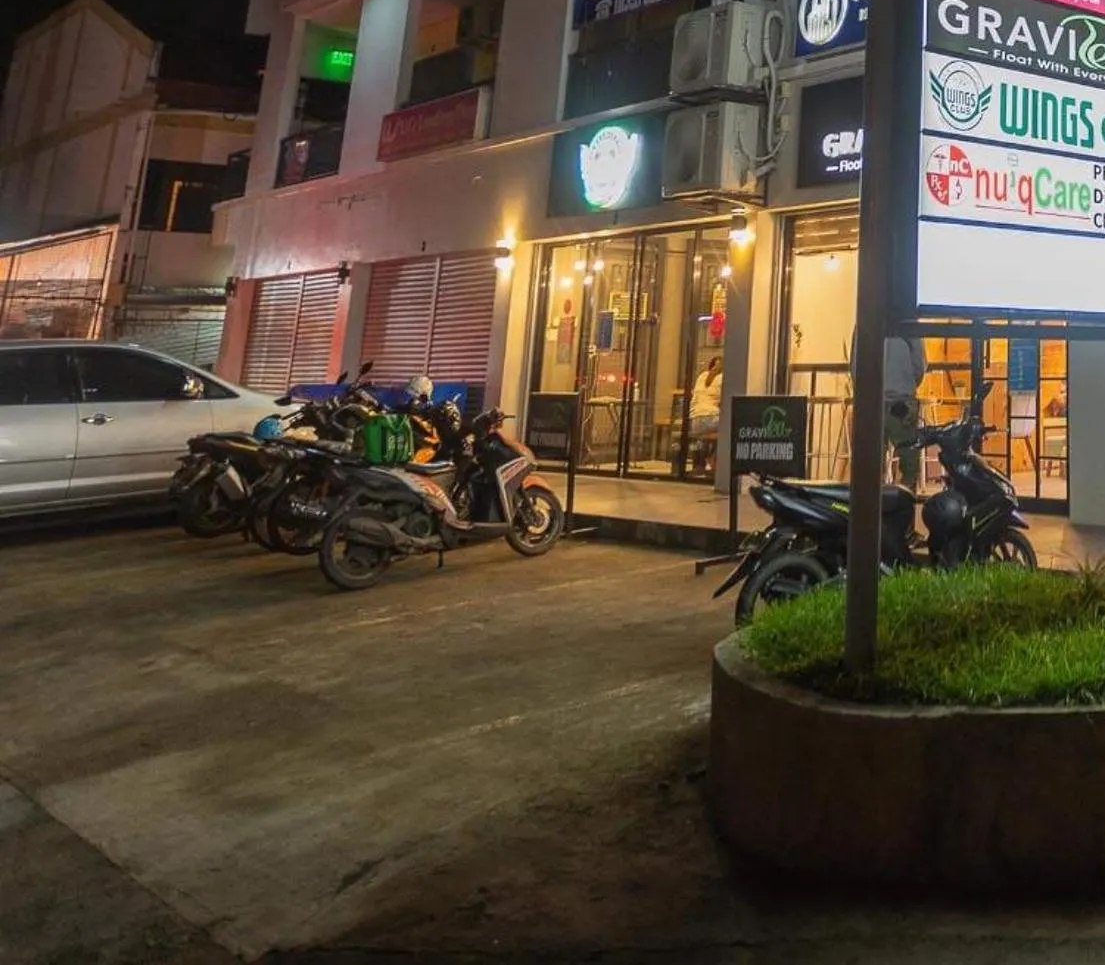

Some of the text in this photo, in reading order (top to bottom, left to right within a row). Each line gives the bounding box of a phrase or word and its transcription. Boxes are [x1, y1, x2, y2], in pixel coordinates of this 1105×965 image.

[993, 48, 1032, 67] Float
[1037, 57, 1069, 74] With
[947, 87, 977, 108] WINGS
[1000, 83, 1094, 149] WINGS
[736, 442, 794, 461] NO PARKING
